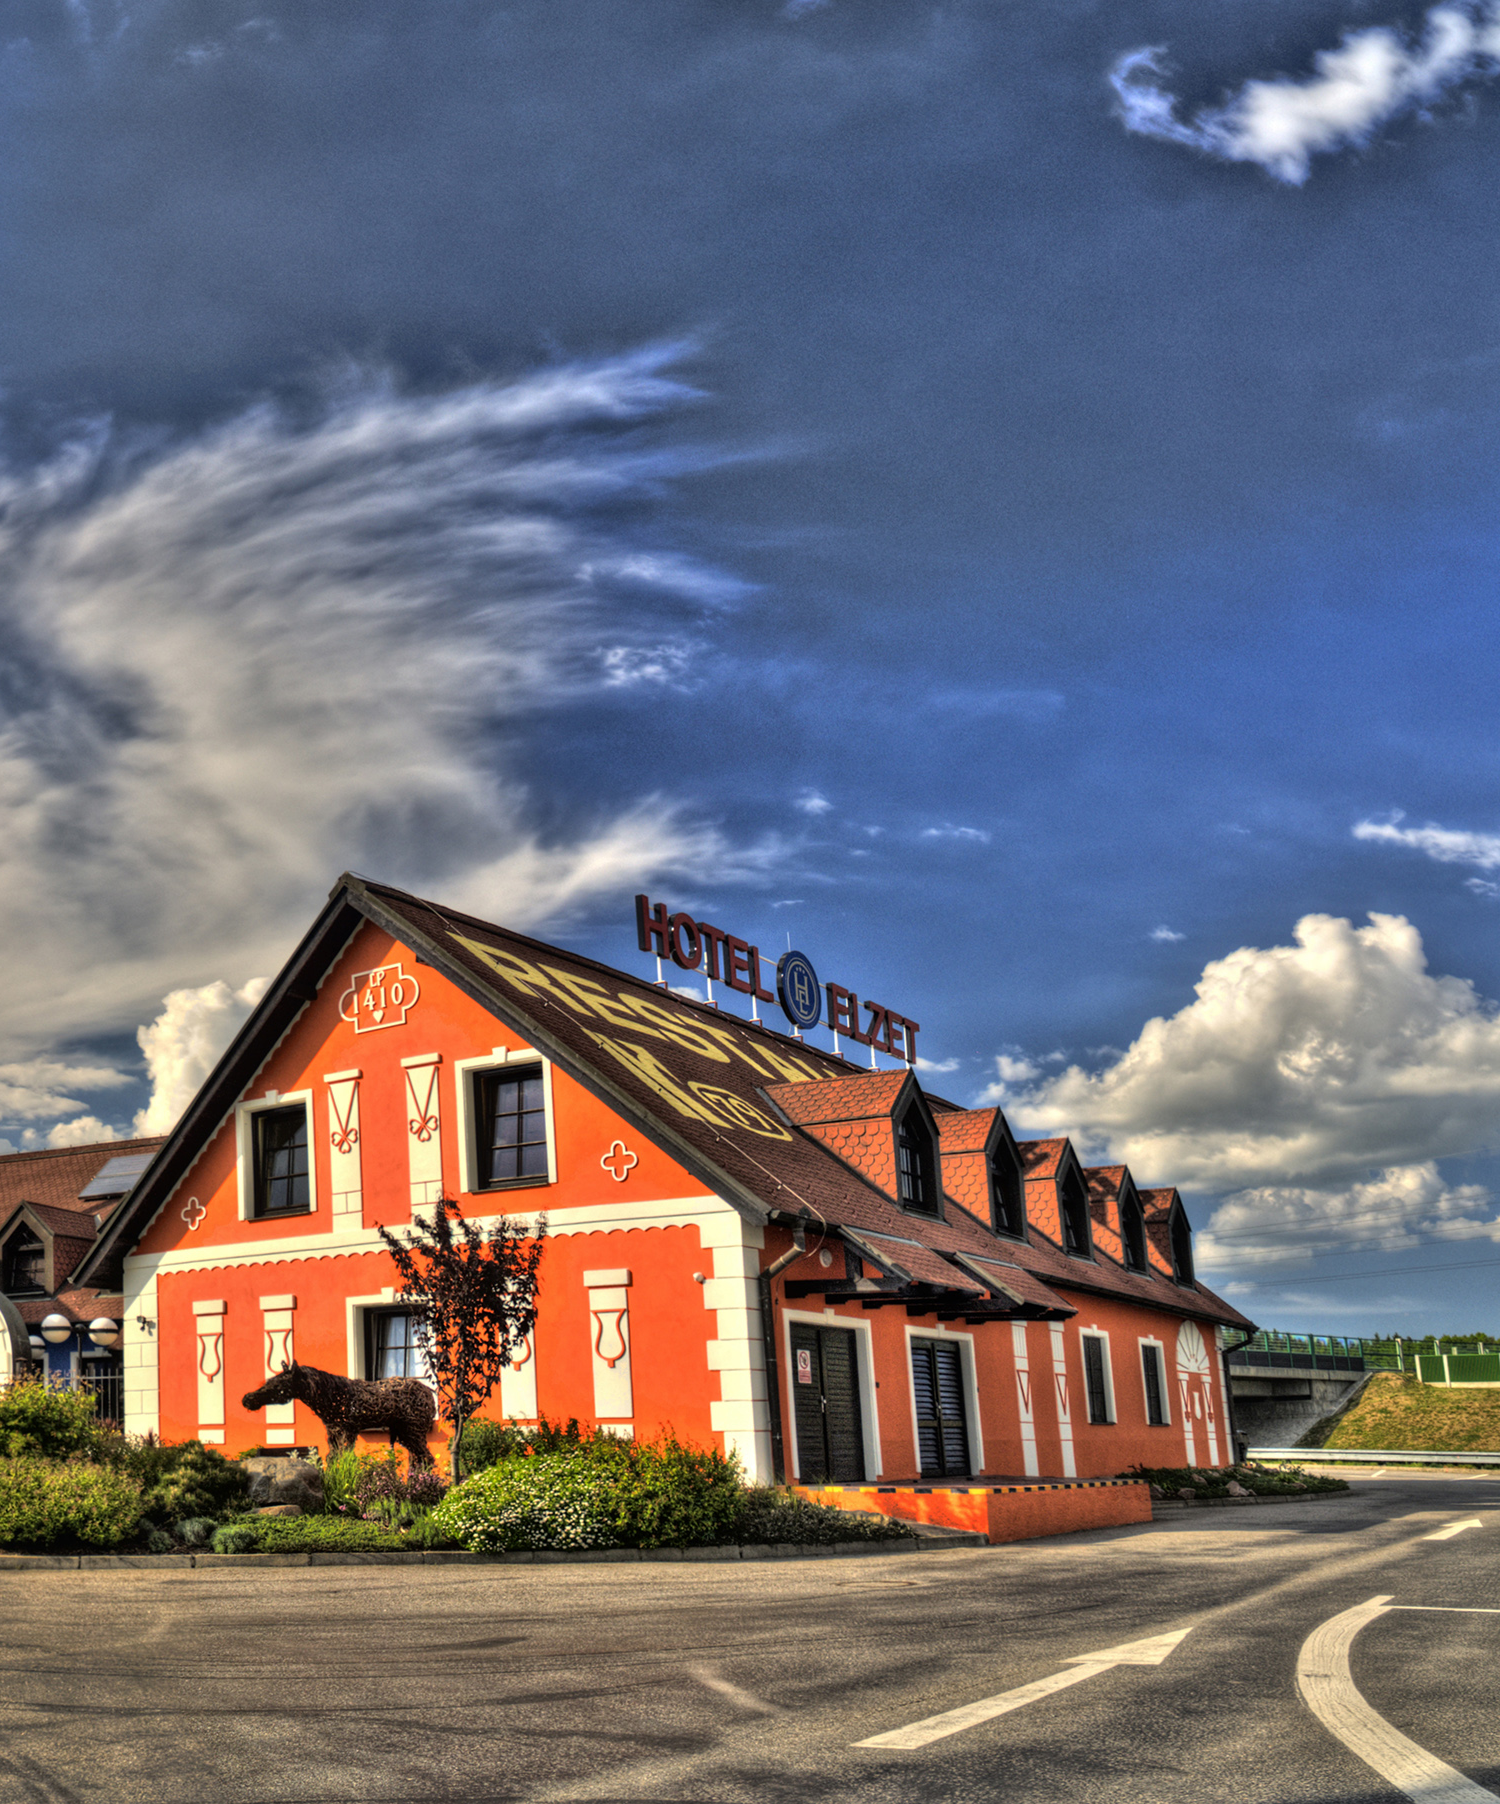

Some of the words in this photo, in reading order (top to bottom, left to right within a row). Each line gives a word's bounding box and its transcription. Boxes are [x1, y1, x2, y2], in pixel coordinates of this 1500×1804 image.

[353, 983, 404, 1015] 1410
[445, 930, 838, 1083] RESTA
[635, 894, 774, 1003] HOTEL
[826, 982, 919, 1064] ELZET
[702, 1090, 772, 1131] 79
